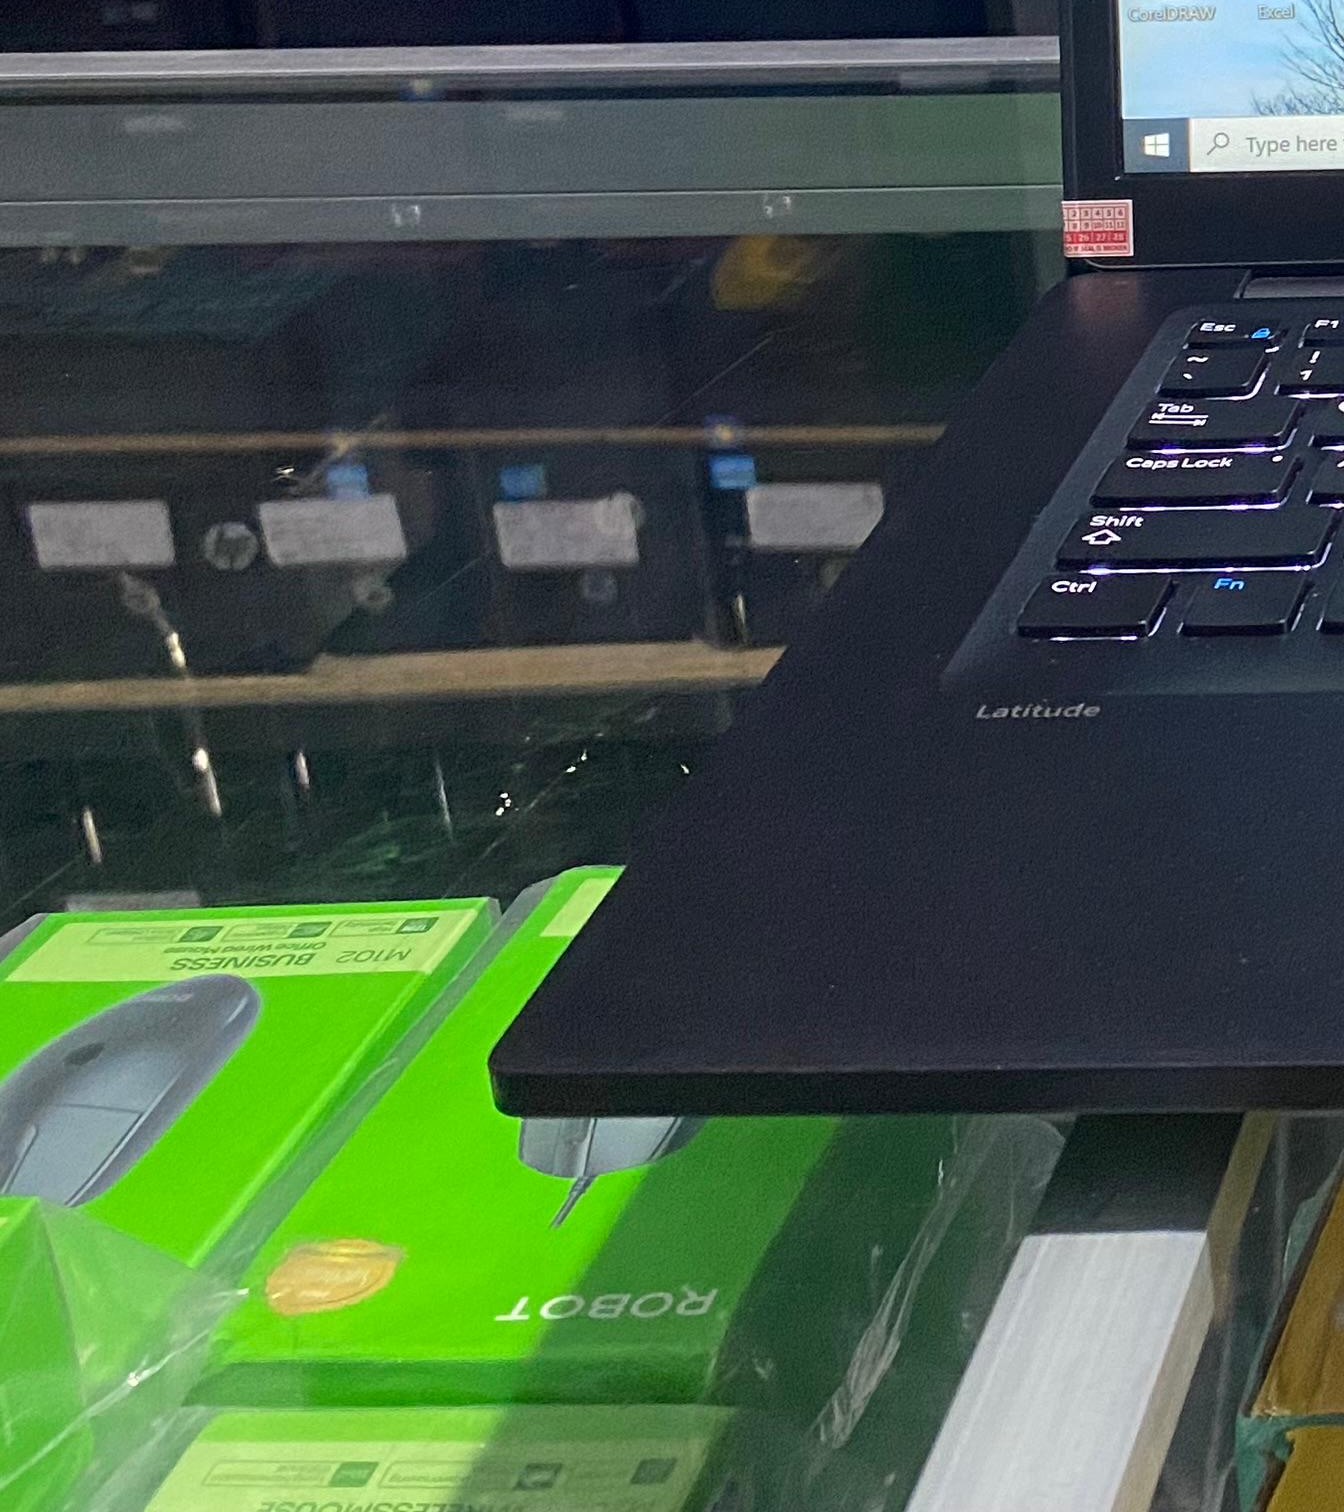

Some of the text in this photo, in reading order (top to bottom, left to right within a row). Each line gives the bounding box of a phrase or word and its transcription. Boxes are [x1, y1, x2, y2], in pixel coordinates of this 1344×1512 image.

[1127, 6, 1217, 22] CorelDRAW
[1257, 3, 1296, 21] Excel
[1246, 136, 1291, 158] Type
[1296, 134, 1338, 154] here
[1199, 321, 1236, 334] Esc
[1314, 319, 1339, 330] F1
[1157, 402, 1194, 414] Tab
[1126, 455, 1233, 472] Caps Lock
[1089, 514, 1143, 528] Shift
[1050, 579, 1097, 594] Ctrl
[1213, 578, 1245, 591] Fn
[975, 701, 1101, 720] Latitude
[222, 943, 274, 955] Wired
[275, 941, 328, 953] Office
[169, 951, 317, 972] BUSINESS
[335, 946, 413, 965] M102
[495, 1284, 718, 1323] ROBOT
